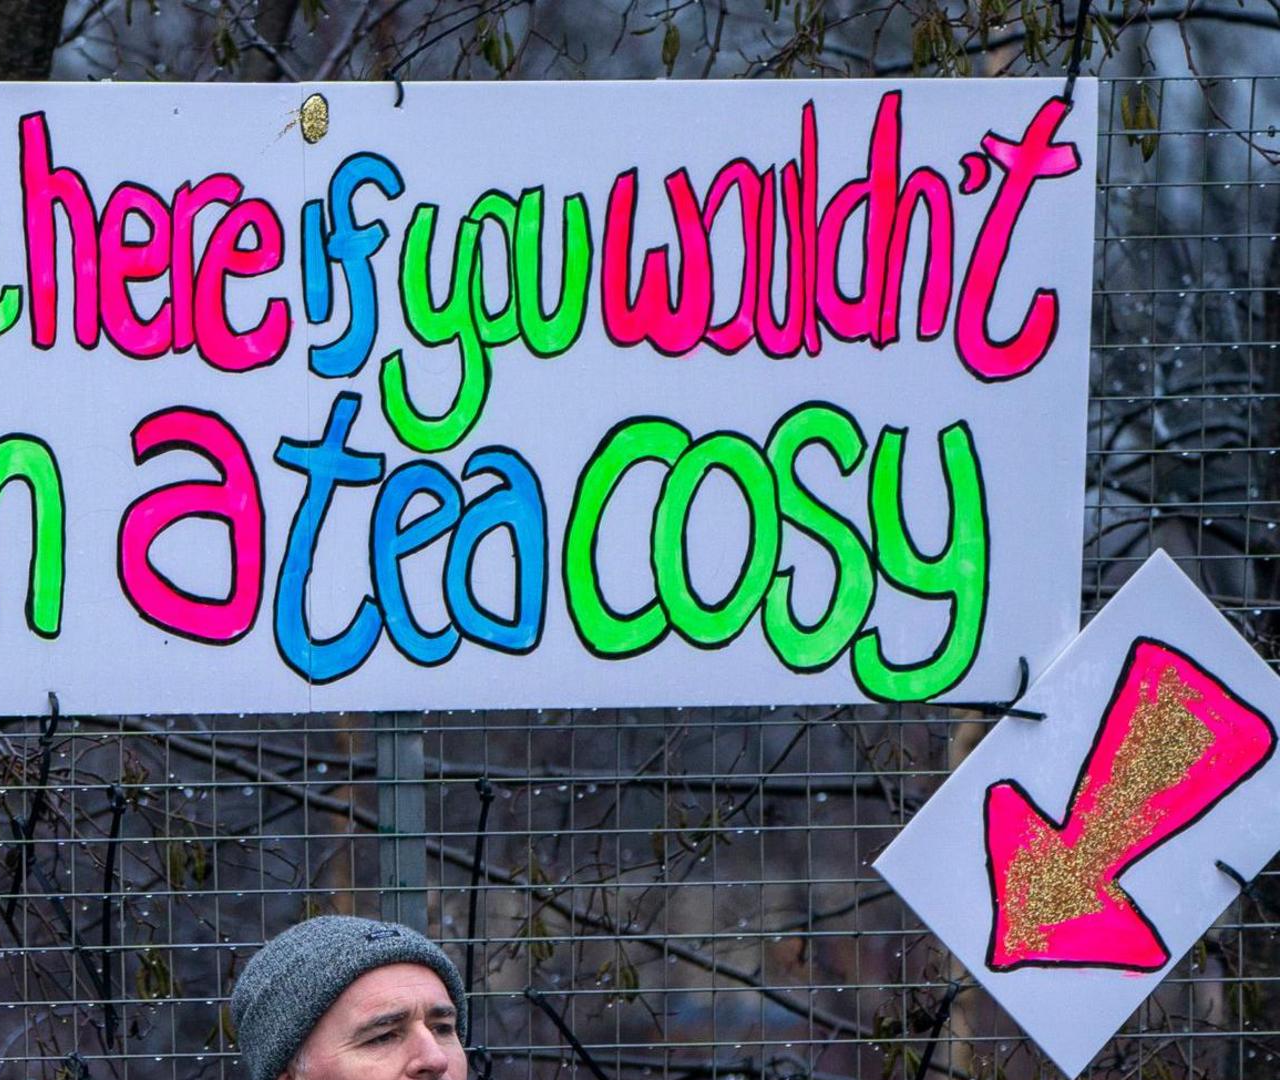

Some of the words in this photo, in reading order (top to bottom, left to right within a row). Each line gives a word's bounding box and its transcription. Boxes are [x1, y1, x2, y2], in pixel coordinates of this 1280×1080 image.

[19, 111, 292, 373] here
[301, 94, 405, 379] if
[381, 185, 592, 454] you
[601, 89, 1082, 384] wouldn't
[117, 405, 267, 645] a
[273, 391, 548, 685] tea
[561, 399, 990, 705] cosy
